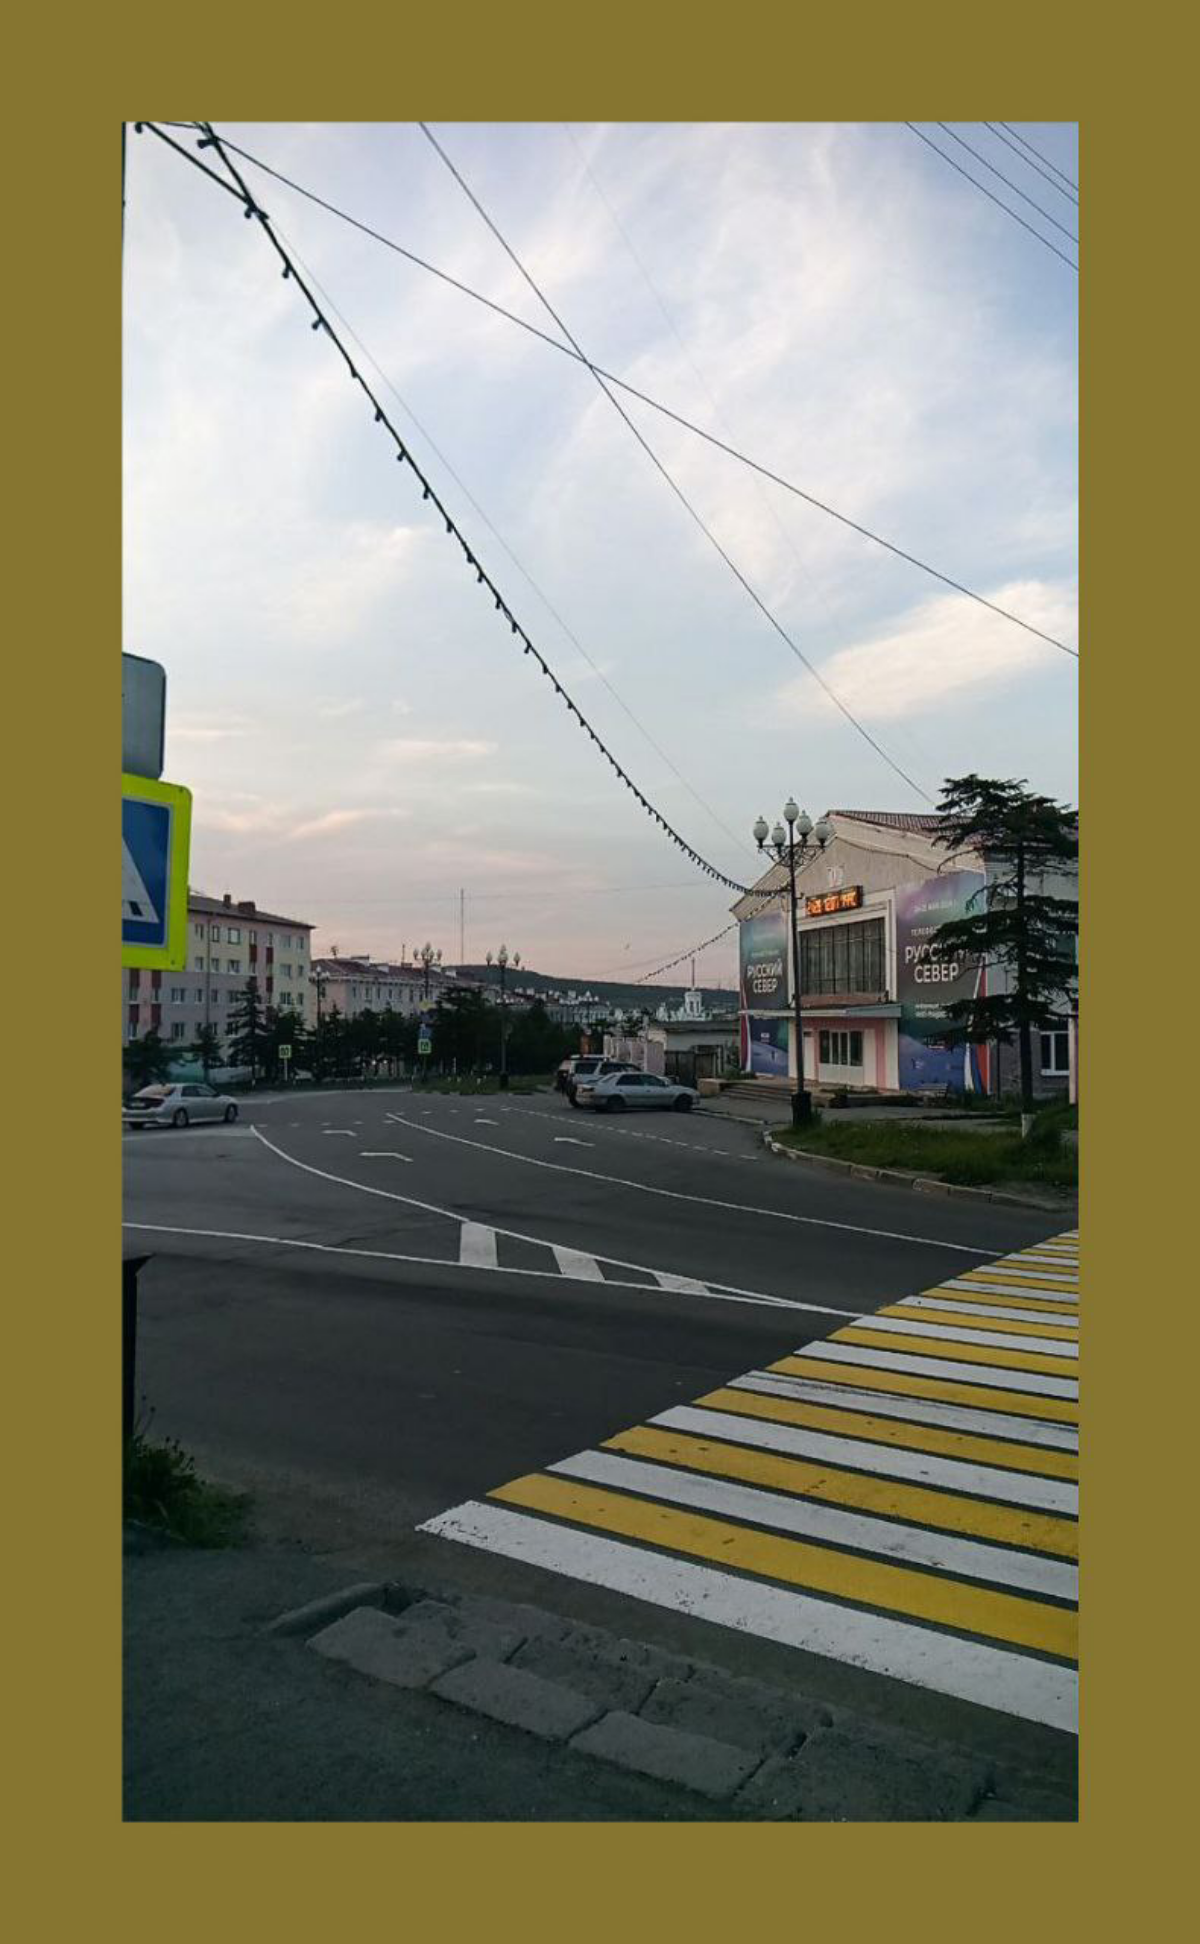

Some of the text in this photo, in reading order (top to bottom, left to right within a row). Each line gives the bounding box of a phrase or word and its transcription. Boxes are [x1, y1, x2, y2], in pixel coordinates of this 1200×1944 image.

[747, 957, 782, 978] РУССКИЙ
[914, 963, 959, 983] СЕВЕР
[753, 979, 778, 993] СЕВЕР
